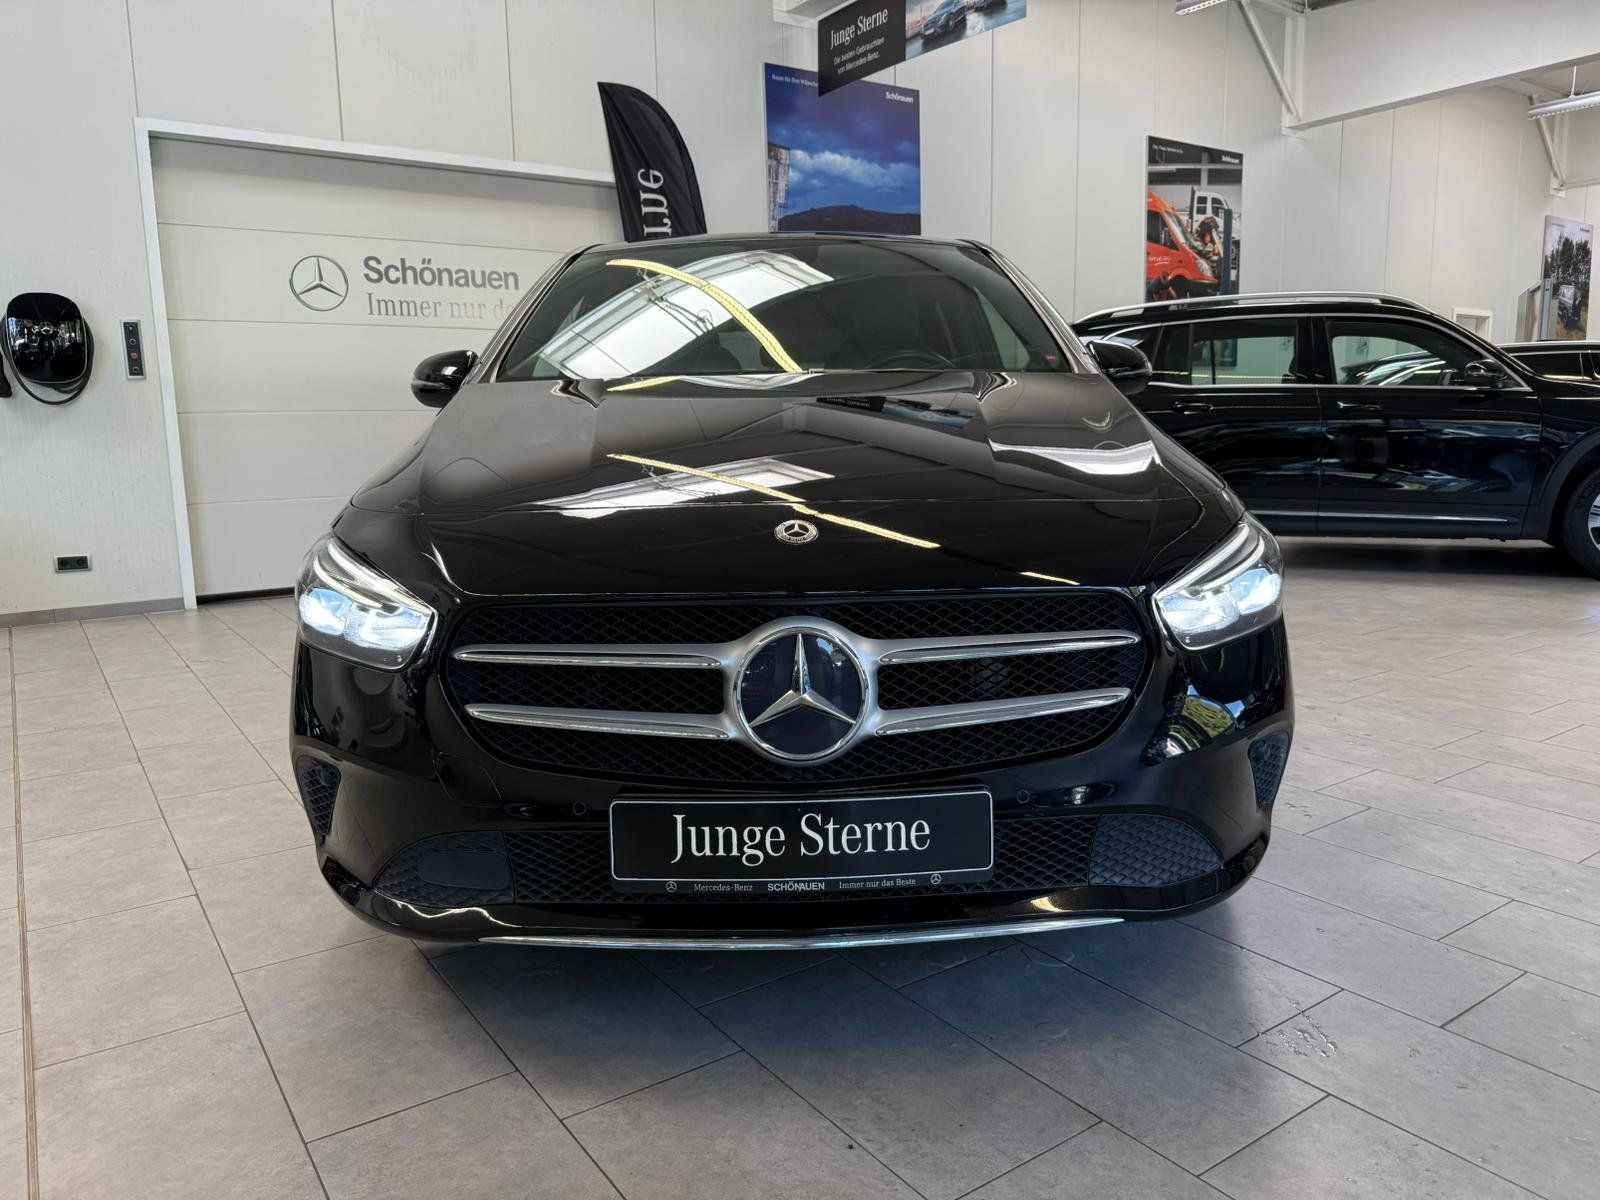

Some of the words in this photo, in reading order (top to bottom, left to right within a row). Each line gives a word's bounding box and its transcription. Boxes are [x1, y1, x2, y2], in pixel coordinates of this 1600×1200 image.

[830, 24, 856, 50] Junge
[857, 8, 889, 36] Sterne
[363, 255, 520, 291] Schönauen
[366, 292, 442, 318] Immer
[447, 301, 487, 320] nur
[671, 813, 786, 867] Junge
[800, 812, 931, 857] Sterne
[693, 883, 753, 892] Mercedes-Benz
[767, 881, 826, 893] SCHÖNAUEN
[839, 881, 864, 889] Immer
[881, 879, 895, 887] das
[896, 878, 917, 886] Beste
